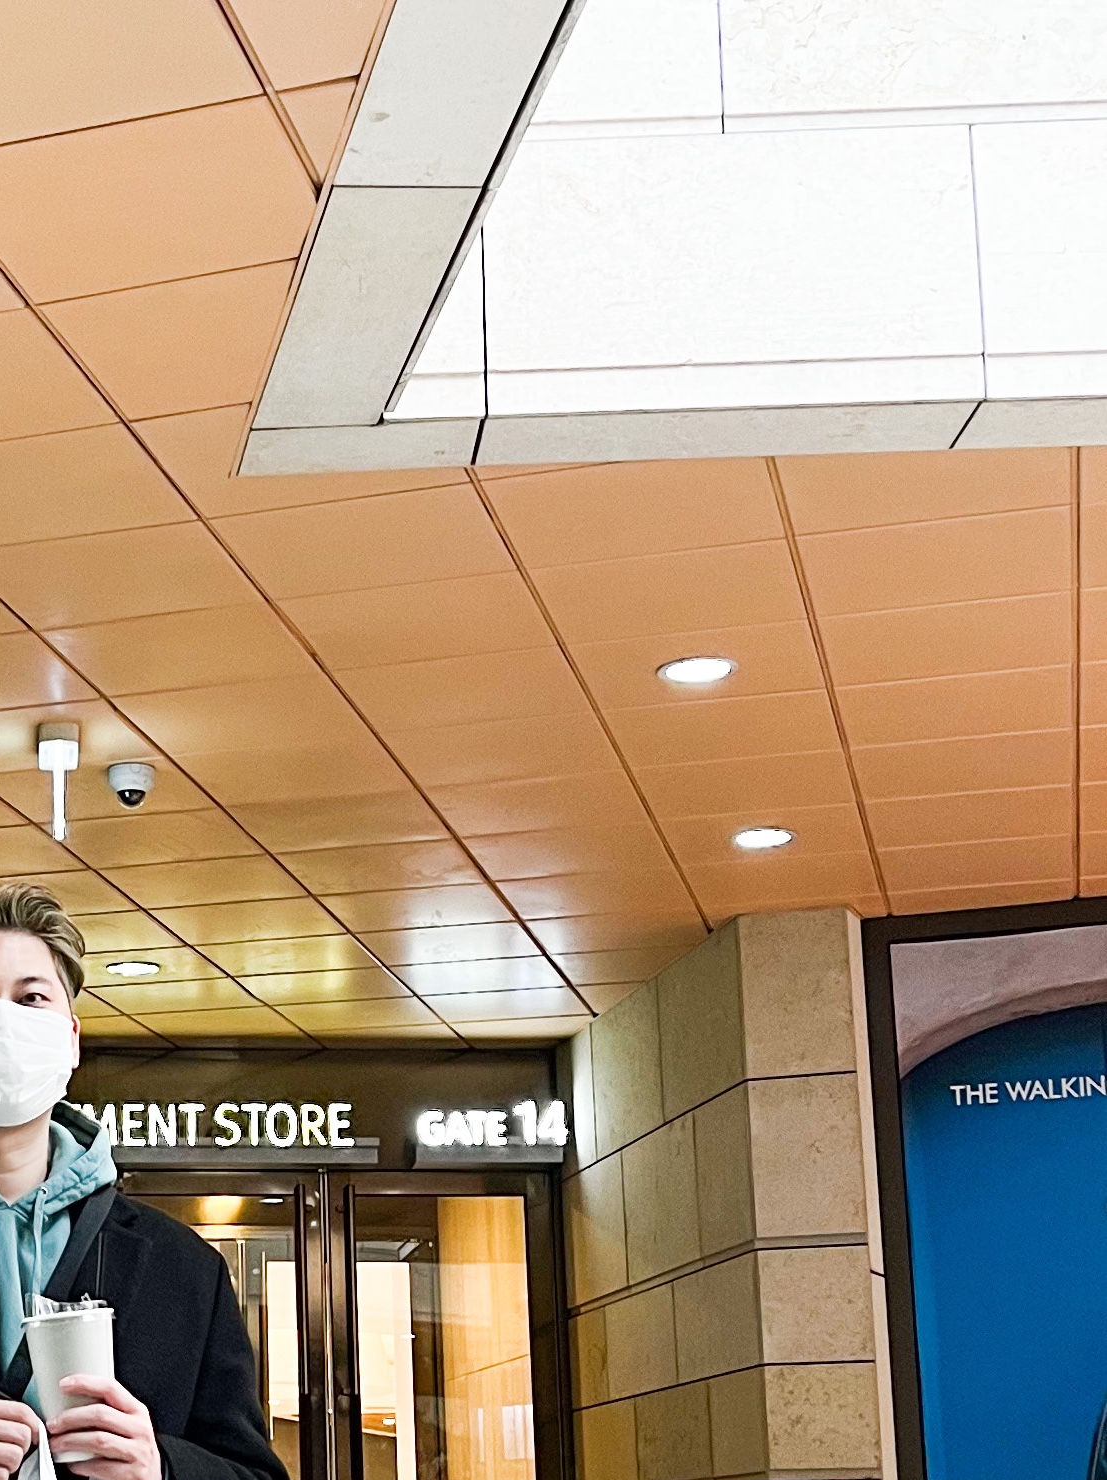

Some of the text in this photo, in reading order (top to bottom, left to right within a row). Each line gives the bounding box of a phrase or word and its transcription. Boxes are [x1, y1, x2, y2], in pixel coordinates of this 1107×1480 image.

[949, 1075, 1106, 1106] THE WALKIN
[76, 1102, 205, 1148] MENT
[213, 1102, 355, 1148] STORE
[416, 1099, 569, 1147] GATE 14
